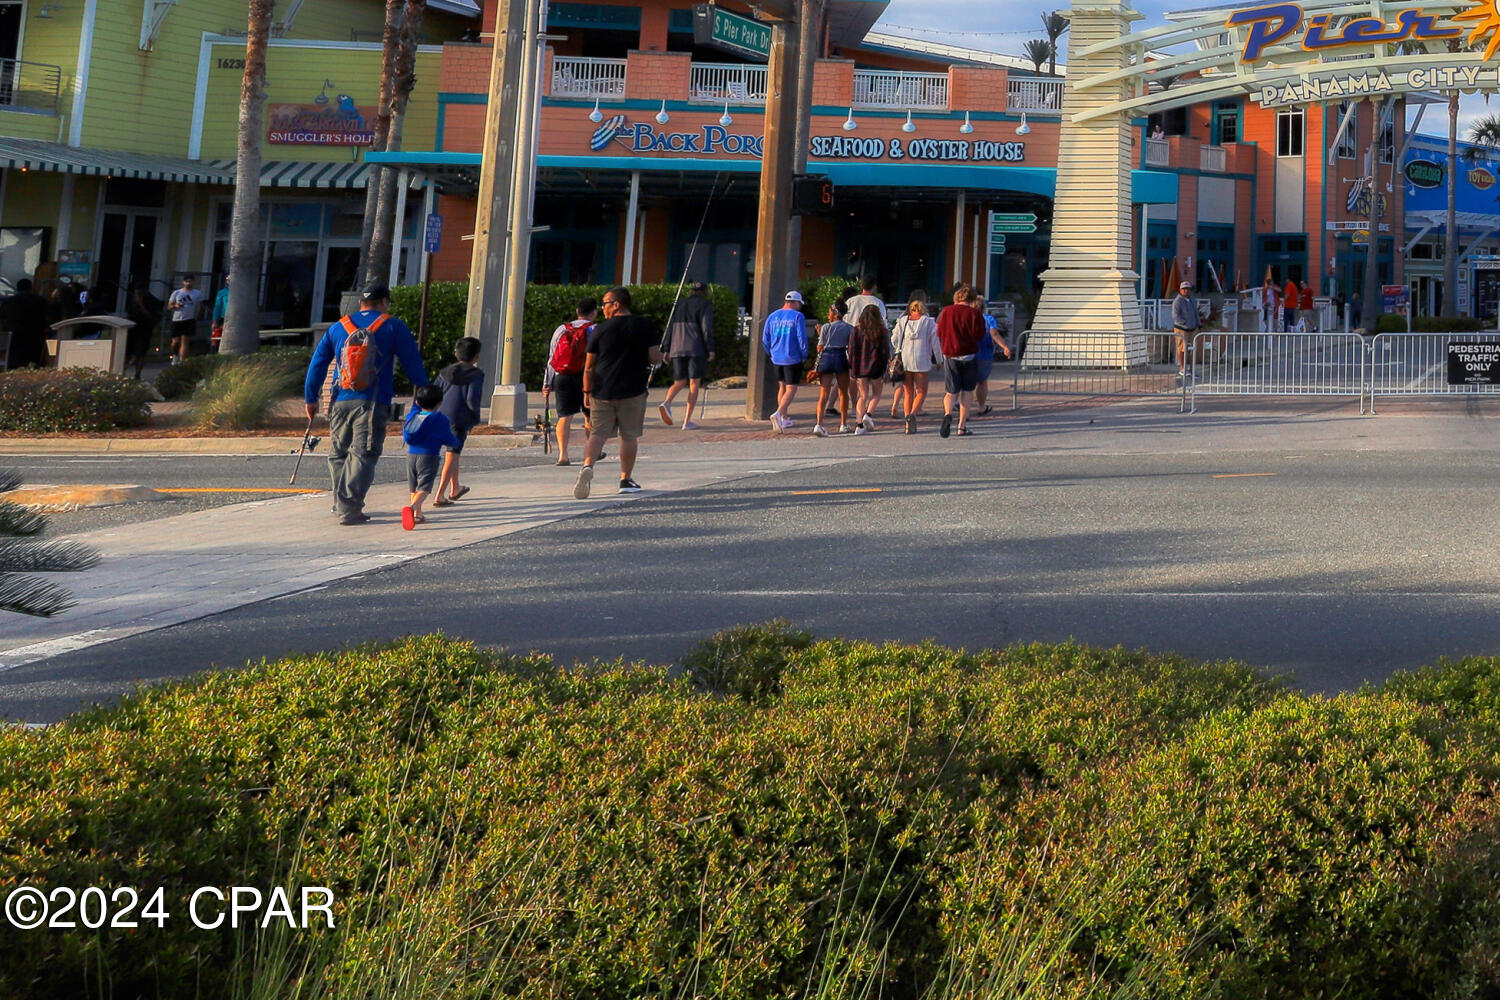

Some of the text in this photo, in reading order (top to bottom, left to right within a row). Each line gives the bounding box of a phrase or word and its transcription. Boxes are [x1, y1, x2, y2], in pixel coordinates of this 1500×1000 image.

[714, 15, 769, 49] S Pier Park Dr
[1224, 2, 1464, 64] Pier
[1261, 70, 1393, 106] PANAMA
[1407, 66, 1482, 89] CITY
[270, 132, 342, 143] SMUGGLER'S
[632, 123, 701, 153] BACK
[700, 125, 764, 158] PORC
[811, 136, 1025, 162] SEAFOOD & OYSTER HOUSE
[1458, 354, 1500, 362] TRAFFIC
[1465, 362, 1492, 371] ONLY
